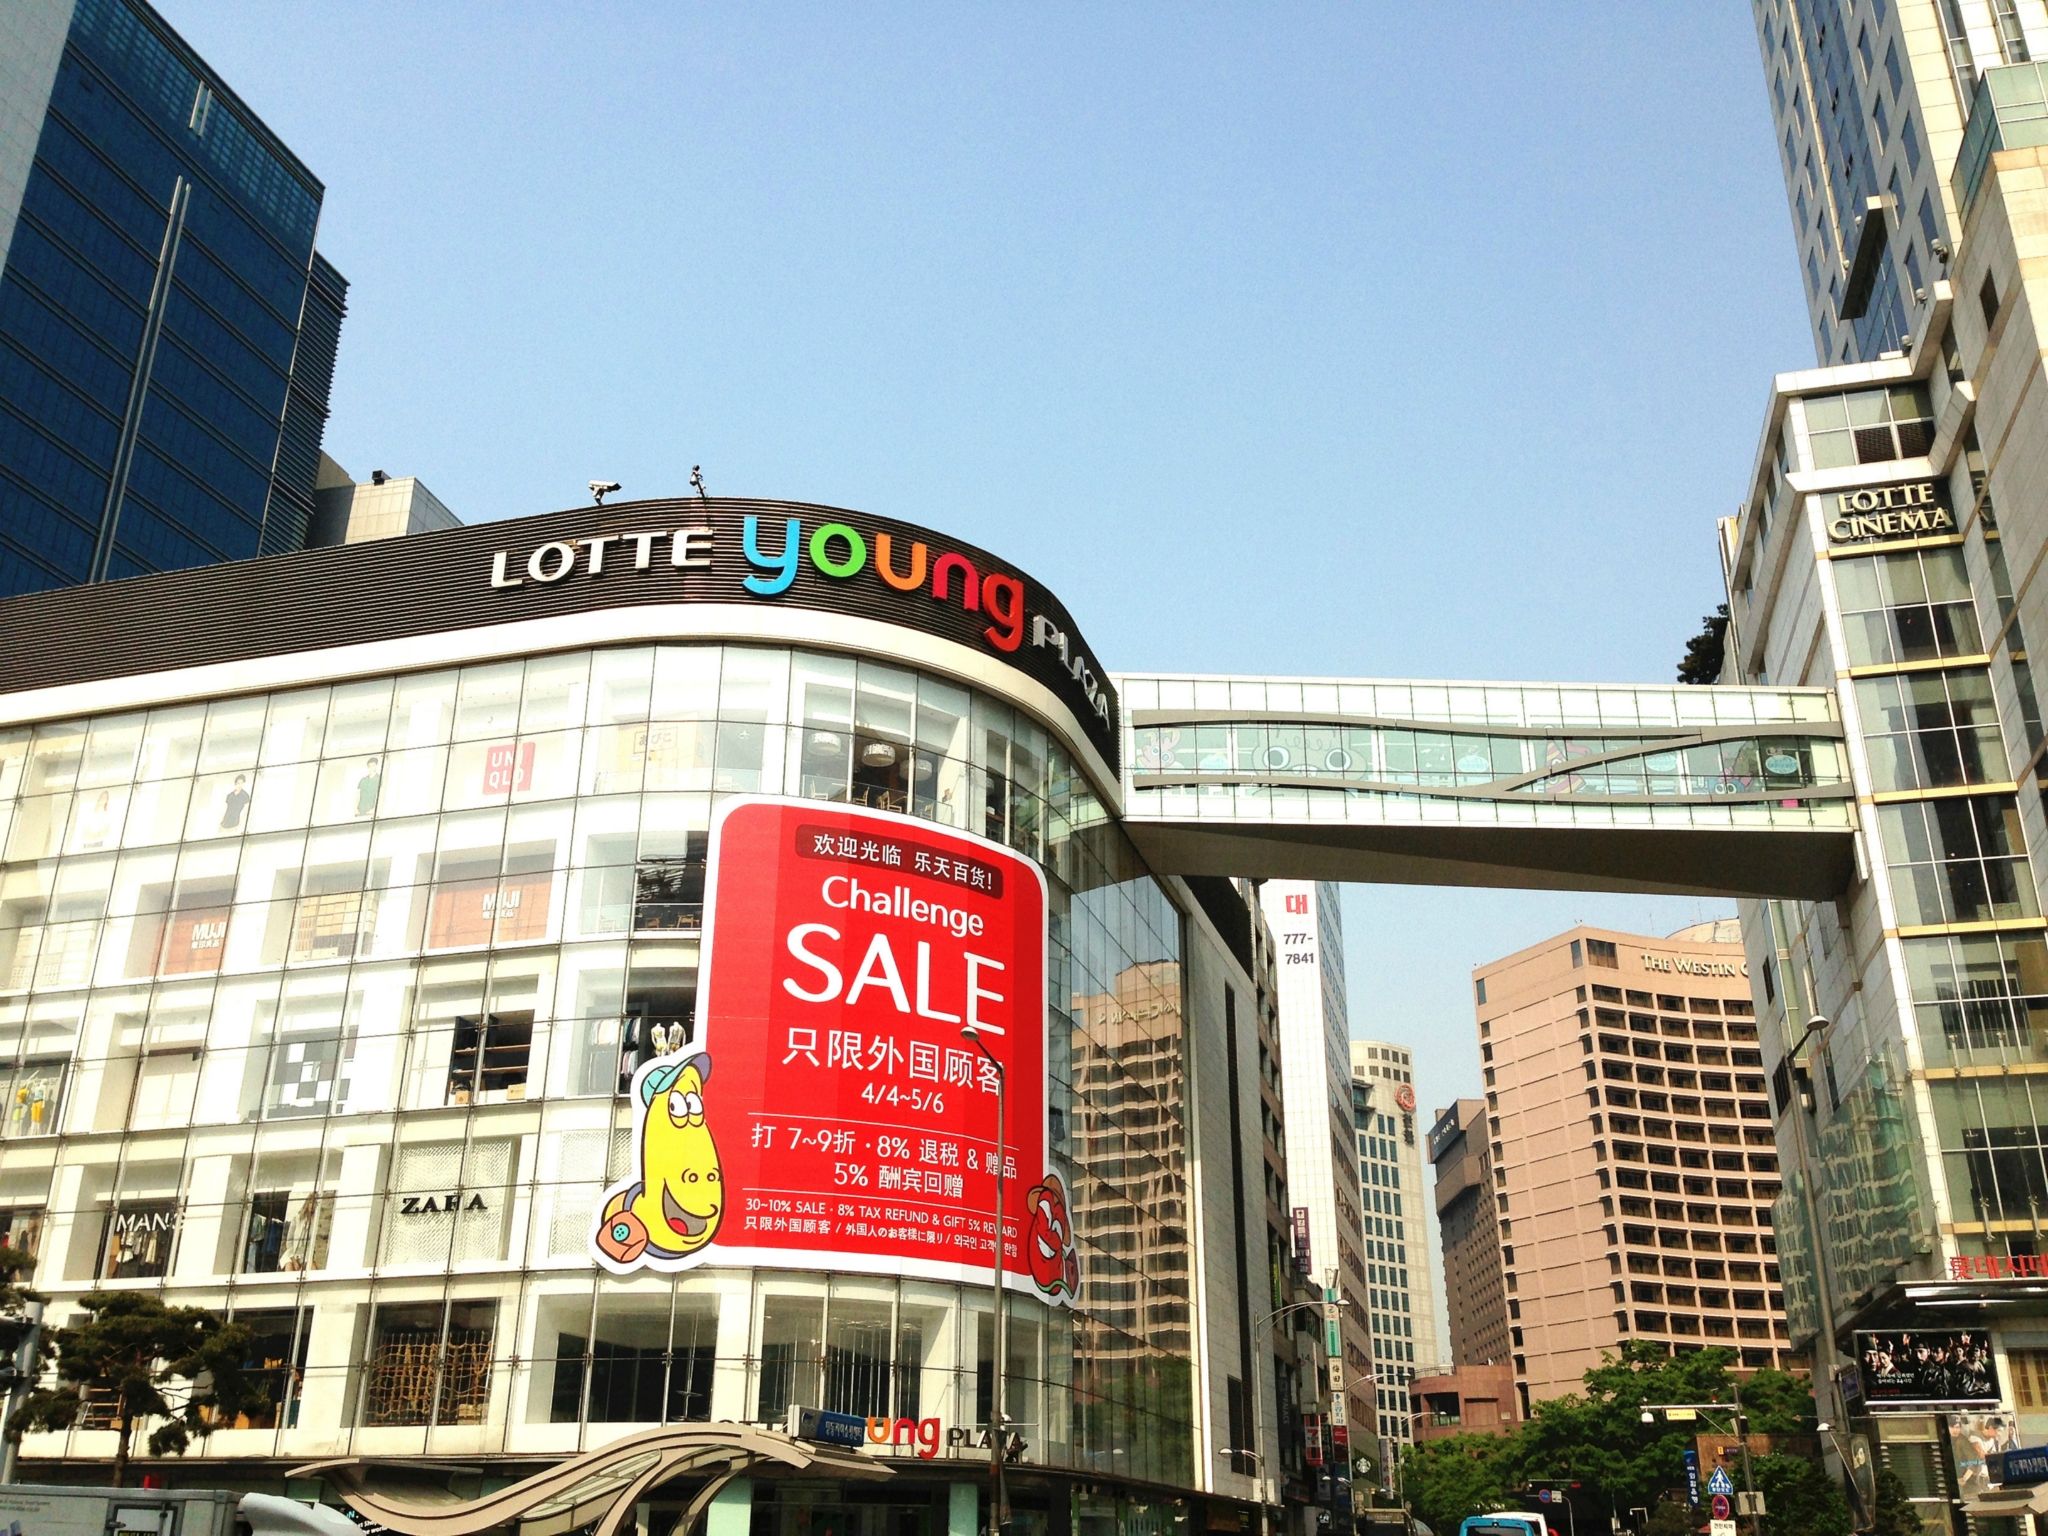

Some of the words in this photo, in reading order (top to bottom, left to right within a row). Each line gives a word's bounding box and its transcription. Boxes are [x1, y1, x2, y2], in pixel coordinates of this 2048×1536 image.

[1838, 483, 1935, 516] LOTTE
[1828, 507, 1954, 542] CINEMA
[490, 528, 715, 588] LOTTE
[741, 514, 1025, 652] young
[1032, 614, 1110, 732] PLAZA
[812, 833, 902, 867] 欢迎光临
[914, 851, 992, 890] 乐天百货!
[821, 875, 984, 938] Challenge
[1286, 894, 1308, 915] 대
[191, 921, 227, 941] MUJI
[1283, 933, 1314, 945] 777-
[1285, 952, 1314, 965] 7841
[782, 922, 1006, 1036] SALE
[781, 1026, 1003, 1096] 只限外国顾客
[861, 1082, 945, 1114] 4/4~5/6
[751, 1122, 777, 1149] 打
[786, 1126, 856, 1155] 7~9折
[876, 1135, 911, 1160] 8%
[918, 1138, 960, 1168] 退税
[966, 1149, 979, 1171] &
[833, 1161, 869, 1187] 5%
[878, 1164, 964, 1199] 酬宾回赠
[400, 1193, 488, 1215] ZARA
[745, 1198, 792, 1213] 30~10%
[795, 1201, 827, 1215] SALE
[837, 1203, 855, 1217] 8%
[859, 1206, 881, 1219] TAX
[885, 1208, 929, 1225] REFUND
[932, 1213, 940, 1226] &
[943, 1214, 967, 1229] GIFT
[968, 1218, 981, 1231] 5%
[744, 1216, 831, 1235] 只限外国顾客
[954, 1234, 978, 1250] 외국인
[980, 1239, 1001, 1254] 고객
